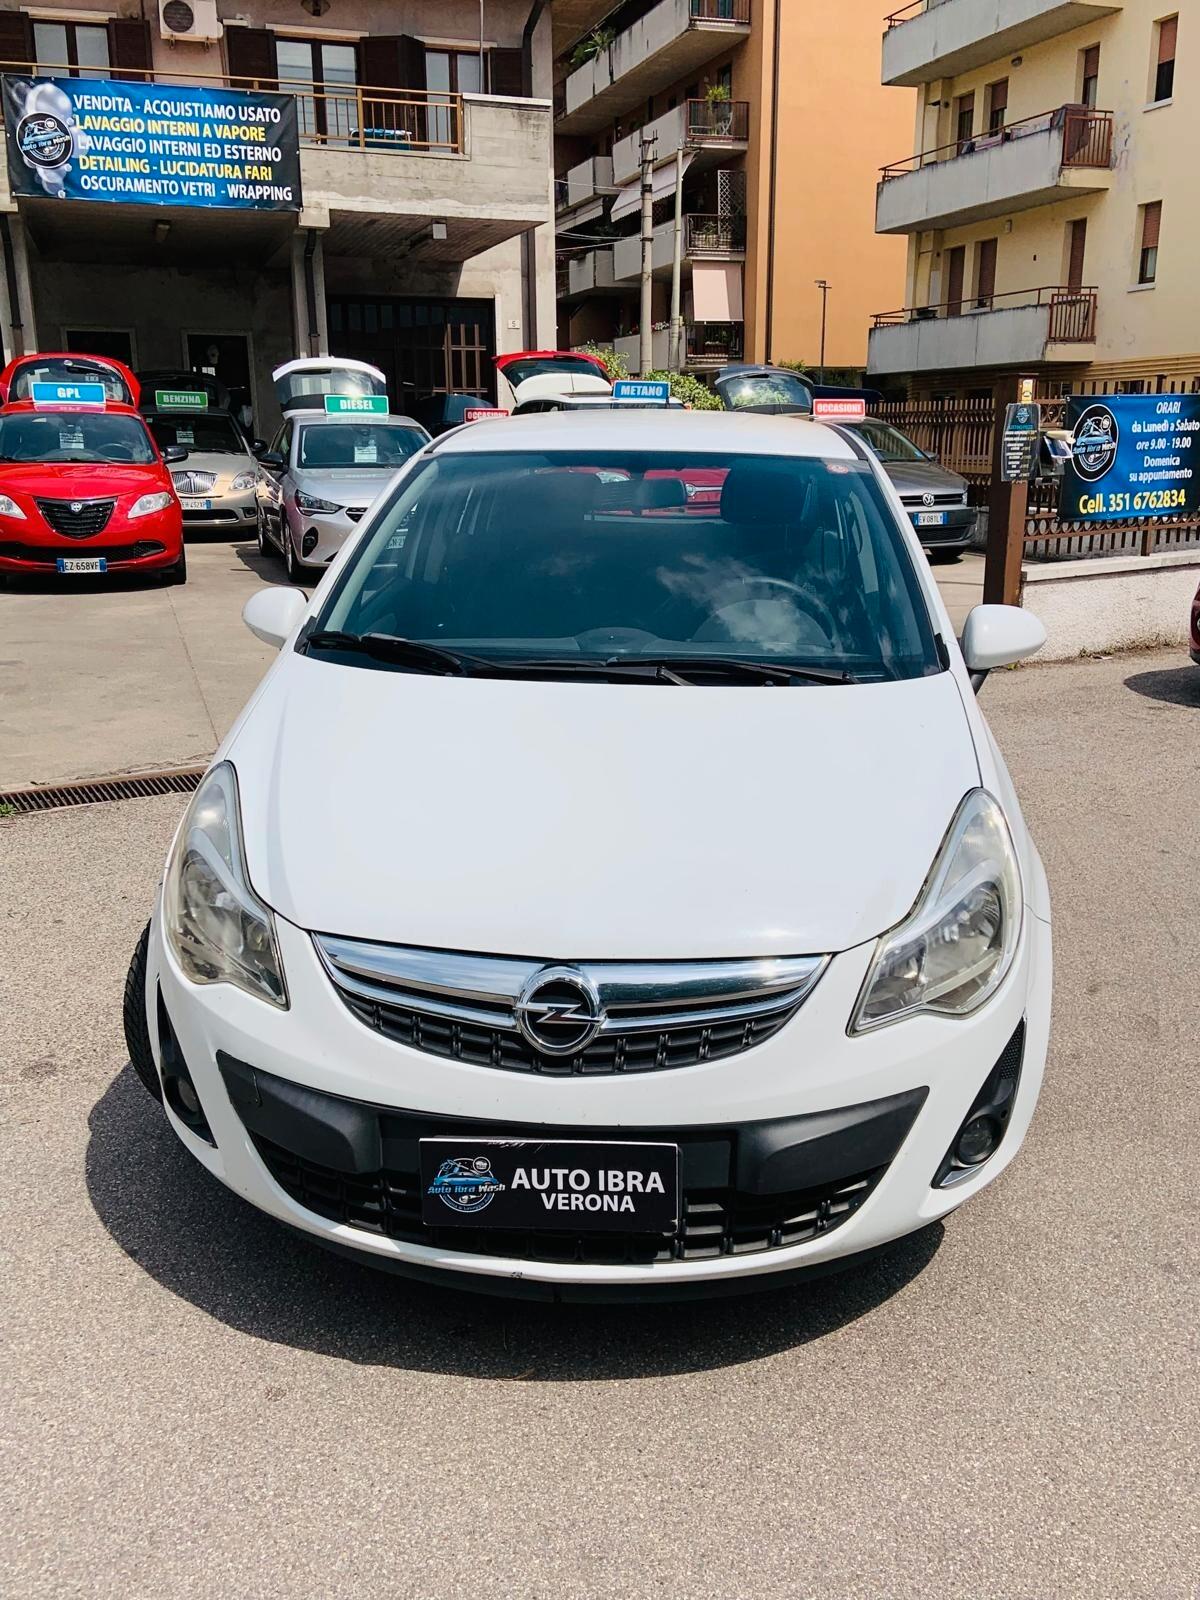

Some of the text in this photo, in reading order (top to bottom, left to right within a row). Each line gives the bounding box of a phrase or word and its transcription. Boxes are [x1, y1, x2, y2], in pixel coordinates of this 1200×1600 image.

[73, 94, 133, 112] VENDITA
[144, 99, 236, 120] ACQUISTIAMO
[238, 106, 280, 123] USATO
[76, 114, 266, 142] LAVAGGIO INTERNI A VAPORE
[78, 135, 146, 153] LAVAGGIO
[149, 140, 200, 157] INTERNI
[204, 142, 222, 158] ED
[224, 144, 282, 162] ESTERNO
[79, 155, 150, 174] DETAILING
[160, 160, 242, 180] LUCIDATURA
[244, 166, 272, 180] FARI
[80, 174, 179, 195] OSCURAMENTO
[180, 181, 216, 197] VETRI
[56, 388, 81, 398] GPL
[620, 385, 663, 396] METANO
[162, 394, 200, 404] BENZINA
[340, 400, 374, 410] DIESEL
[817, 403, 862, 413] OCCASIONE
[1156, 402, 1181, 414] ORARI
[1132, 418, 1200, 433] da Lunedì a Sabato
[1136, 441, 1149, 450] ore
[1150, 438, 1166, 450] 9.00
[1172, 437, 1192, 448] 19.00
[1144, 454, 1180, 468] Domenica
[1129, 468, 1193, 484] su appuntamento
[1079, 488, 1186, 514] Cell. 351 6762834
[511, 1168, 666, 1193] AUTO IBRA
[540, 1193, 636, 1212] VERONA
